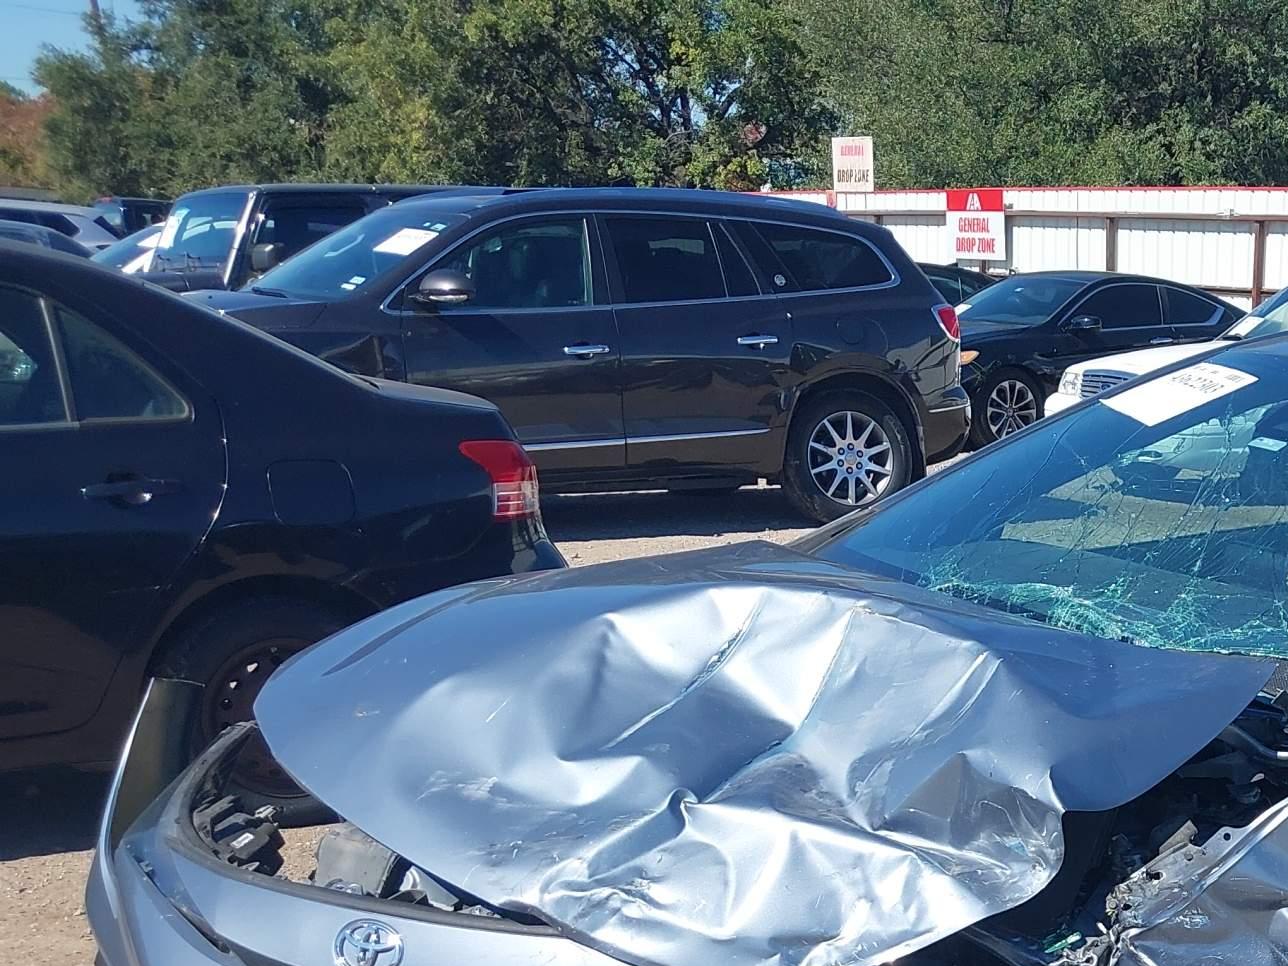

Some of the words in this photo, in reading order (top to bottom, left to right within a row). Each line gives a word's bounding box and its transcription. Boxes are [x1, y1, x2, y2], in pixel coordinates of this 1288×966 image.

[837, 169, 853, 183] DROP
[958, 217, 990, 233] GENERAL
[956, 237, 977, 253] DROP
[978, 237, 996, 253] ZONE
